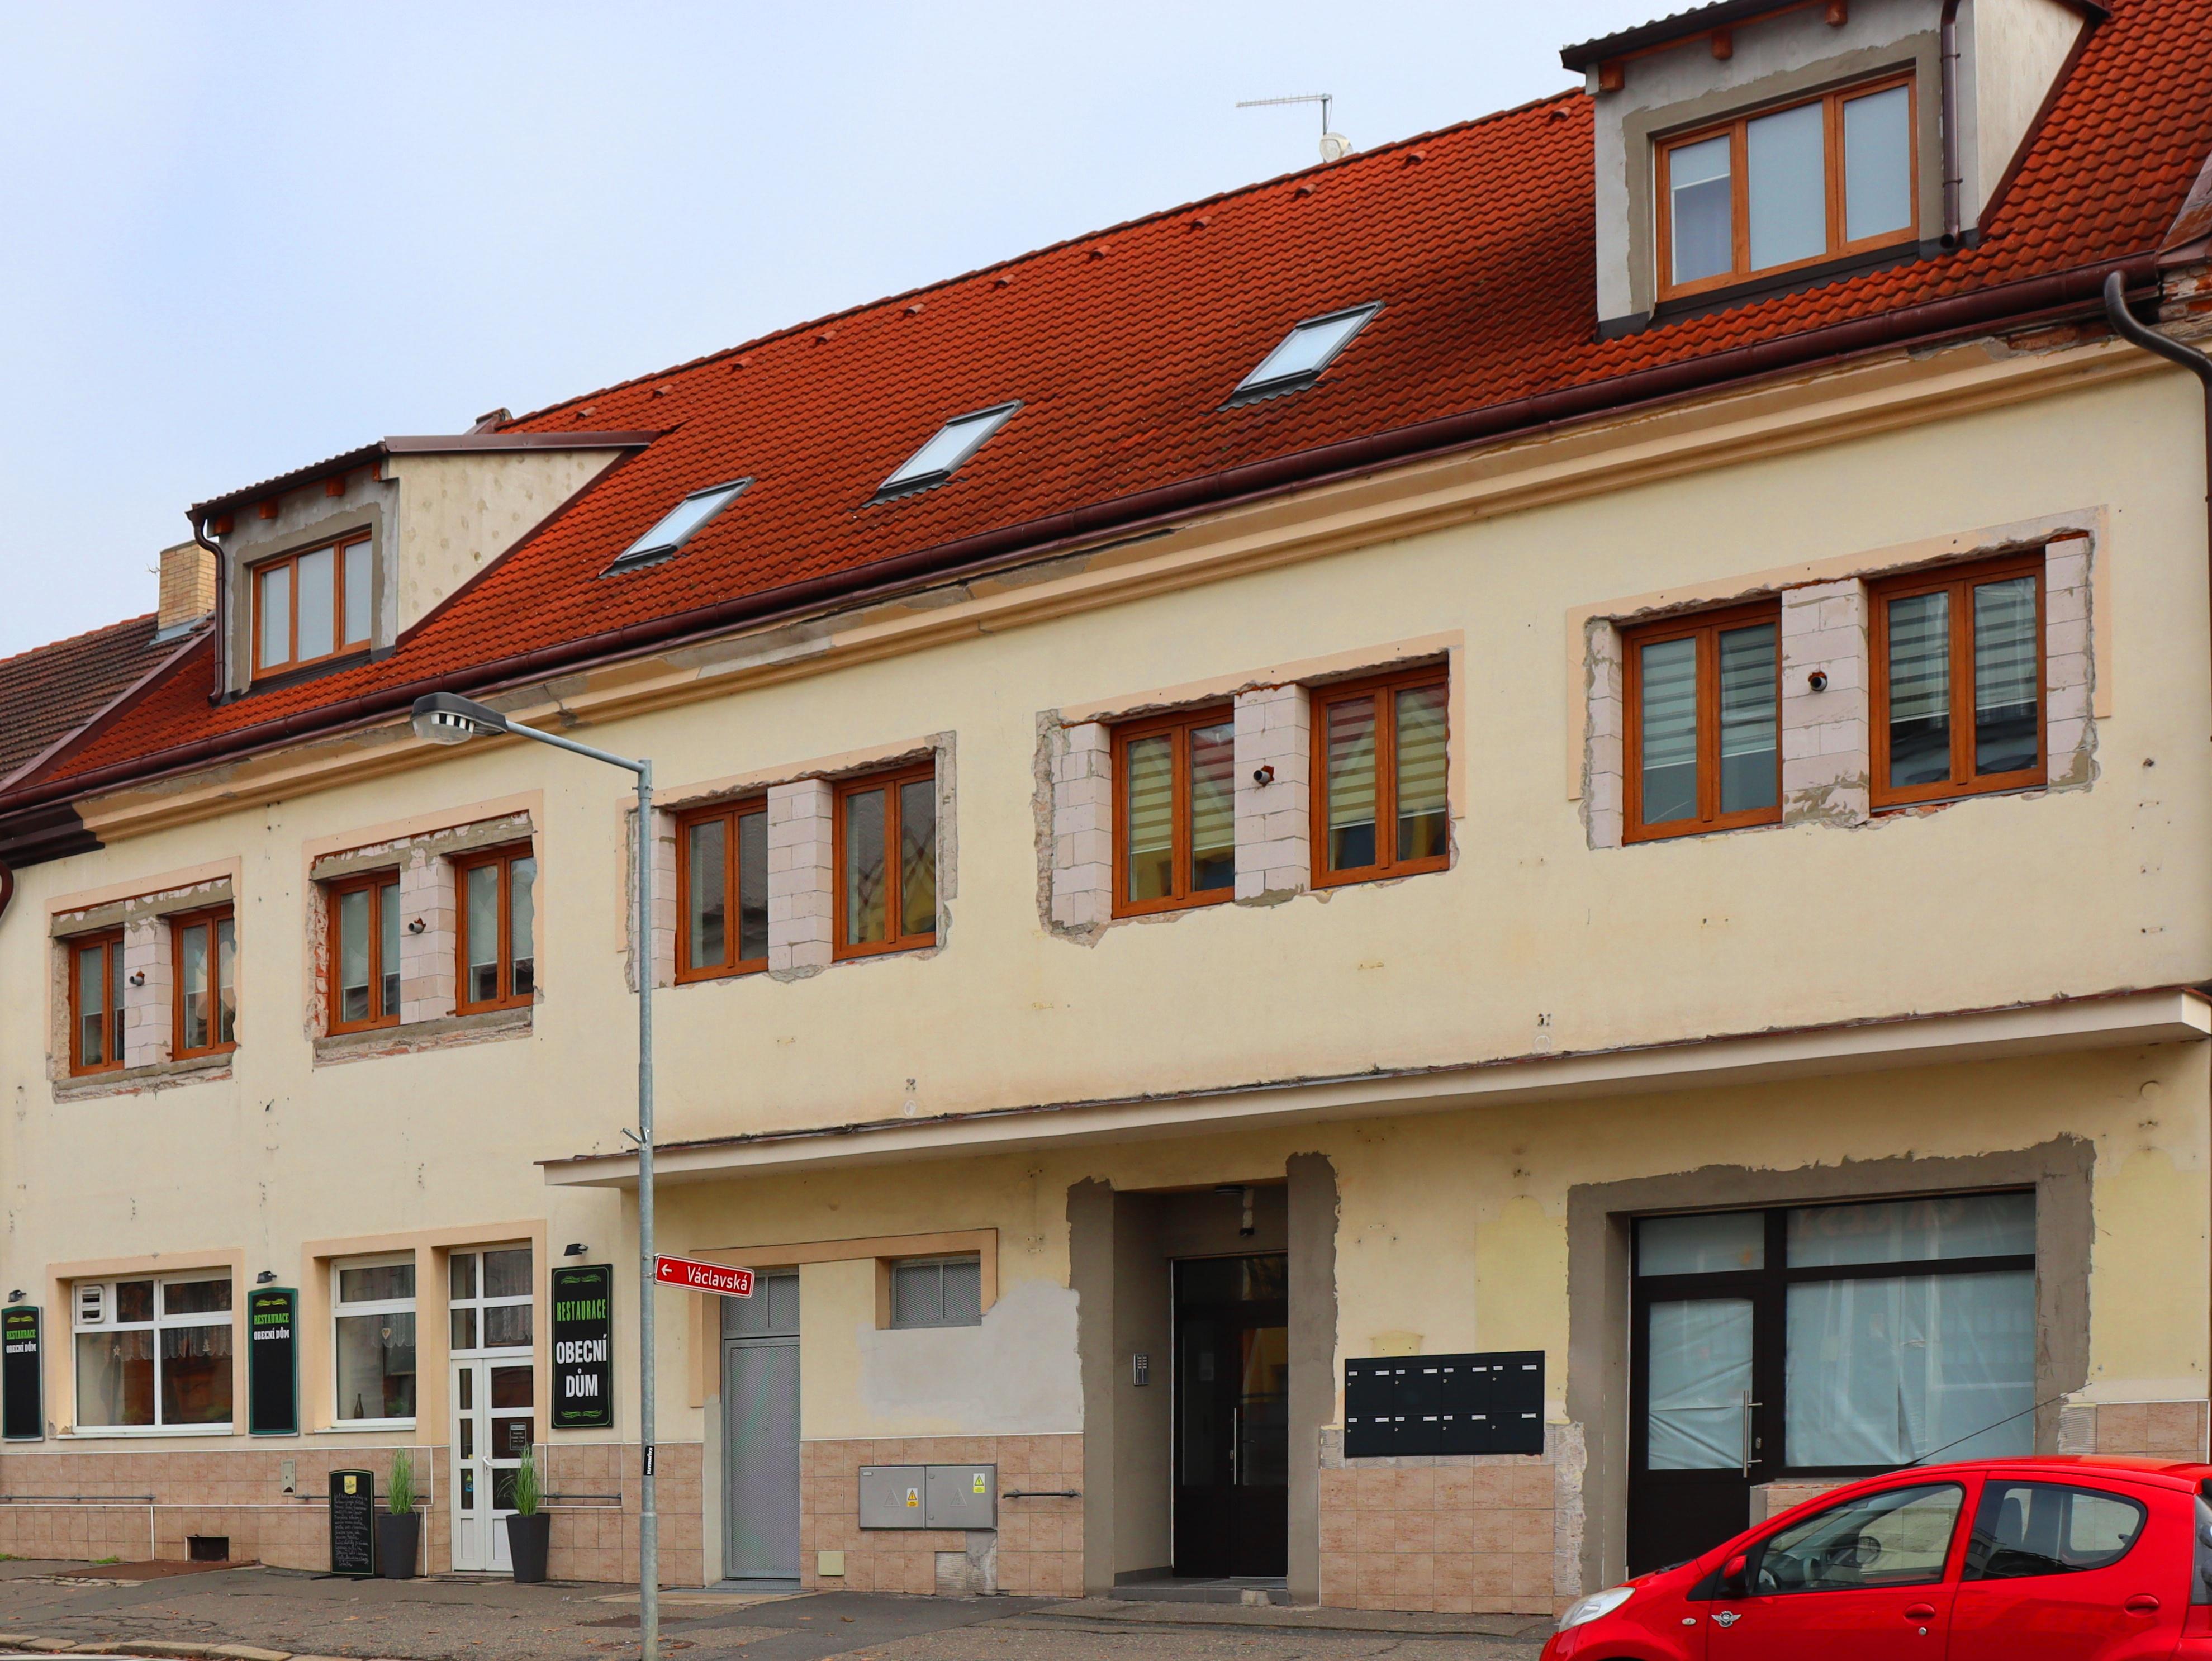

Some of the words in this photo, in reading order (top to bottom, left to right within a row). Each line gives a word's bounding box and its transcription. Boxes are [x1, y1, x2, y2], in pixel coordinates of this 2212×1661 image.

[687, 1265, 748, 1291] Václavská
[253, 1313, 289, 1325] RESTAURACE
[557, 1298, 606, 1322] RESTAURACE
[6, 1329, 36, 1340] RESTAURACE
[253, 1327, 276, 1340] OBECNÍ
[276, 1326, 290, 1339] DŮM
[556, 1333, 607, 1364] OBECNÍ
[566, 1368, 599, 1397] DŮM
